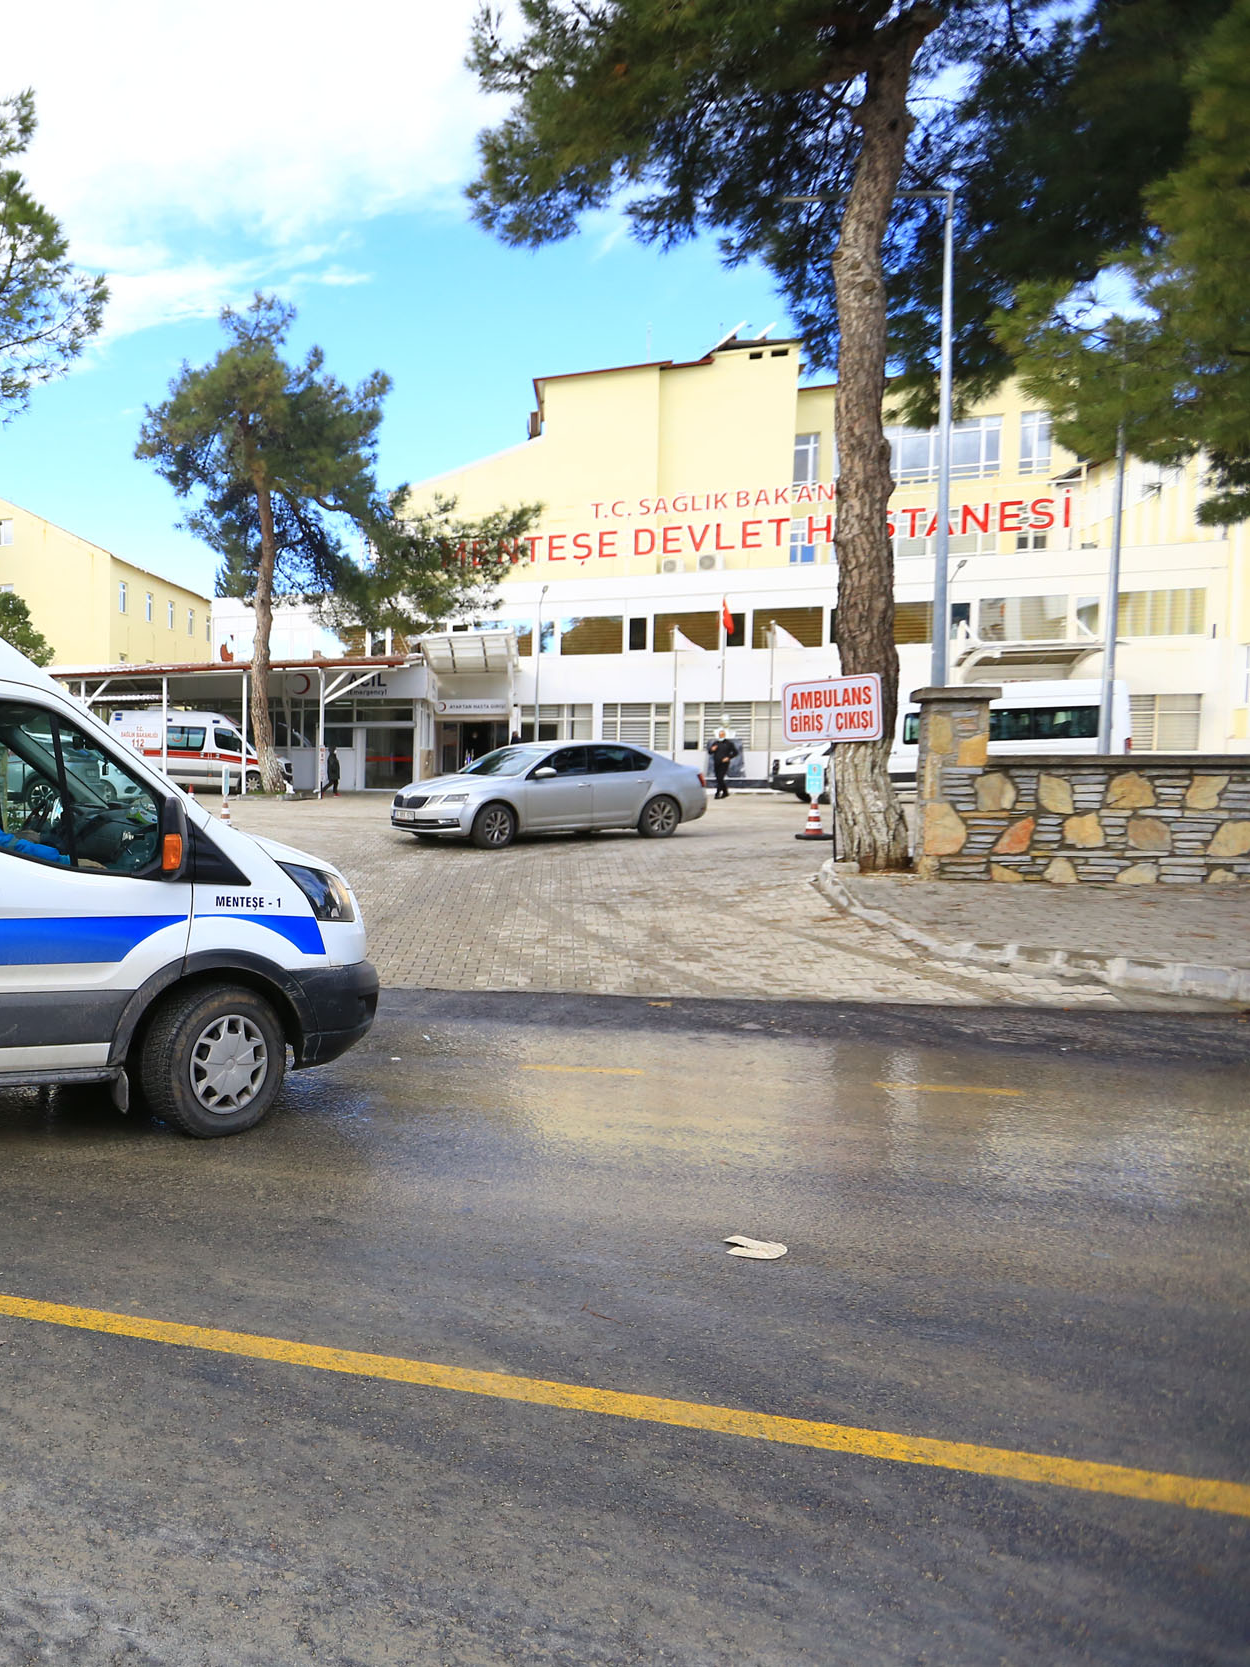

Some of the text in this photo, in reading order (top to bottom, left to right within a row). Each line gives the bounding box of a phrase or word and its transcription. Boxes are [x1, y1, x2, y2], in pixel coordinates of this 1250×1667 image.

[591, 484, 836, 519] T.C. SAĞLIK BAKAN
[634, 517, 791, 556] DEVLET
[807, 488, 1071, 545] HTANESİ
[791, 686, 872, 710] AMBULANS
[791, 710, 873, 733] GİRİŞ / ÇIKIŞI
[132, 739, 145, 748] 112
[216, 896, 264, 911] MENTEŞE
[277, 898, 281, 908] 1
